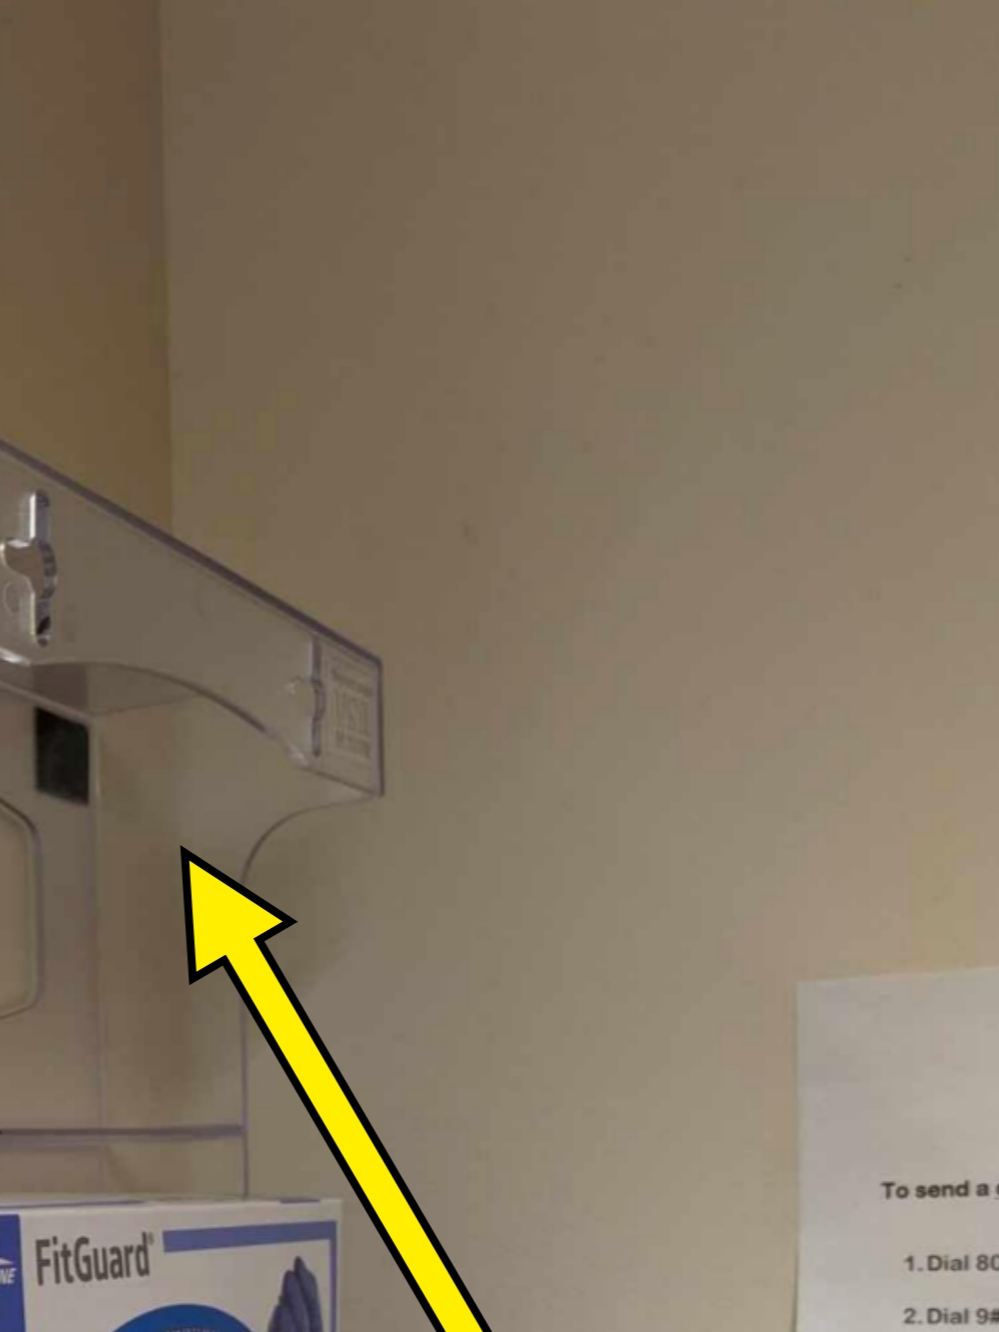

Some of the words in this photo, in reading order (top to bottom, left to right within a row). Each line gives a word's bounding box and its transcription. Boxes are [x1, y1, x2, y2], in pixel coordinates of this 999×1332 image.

[880, 1181, 909, 1200] To
[914, 1179, 970, 1199] send
[976, 1183, 990, 1198] a
[903, 1254, 923, 1272] 1.
[926, 1254, 970, 1272] Dial
[903, 1307, 923, 1325] 2.
[926, 1307, 970, 1325] Dial
